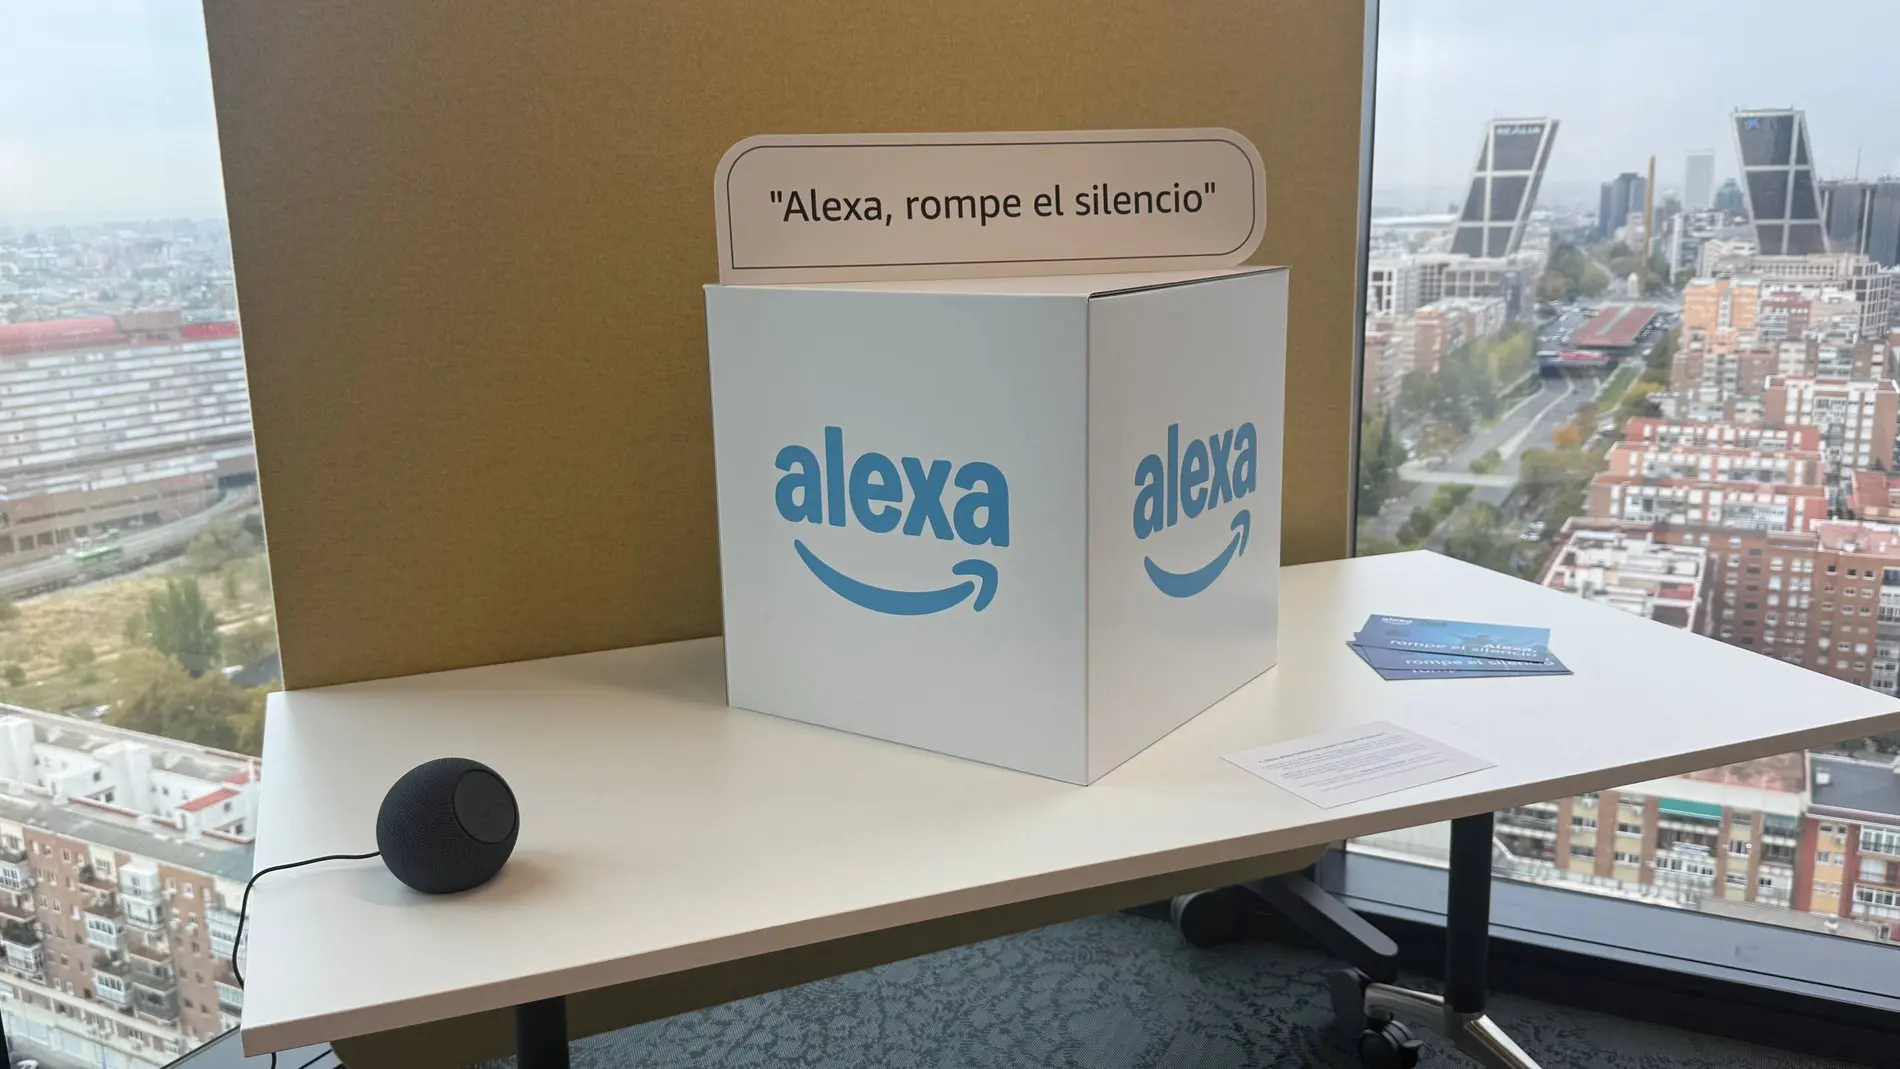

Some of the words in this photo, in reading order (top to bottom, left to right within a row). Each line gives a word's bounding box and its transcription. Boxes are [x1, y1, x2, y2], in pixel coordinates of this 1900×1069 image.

[769, 188, 893, 227] "Alexa,
[906, 194, 1022, 227] rompe
[1033, 184, 1065, 217] el
[1075, 181, 1217, 217] silencio"
[775, 426, 1010, 548] alexa
[1133, 421, 1258, 540] alexa
[1390, 640, 1446, 649] rompe
[1471, 647, 1538, 657] silencio
